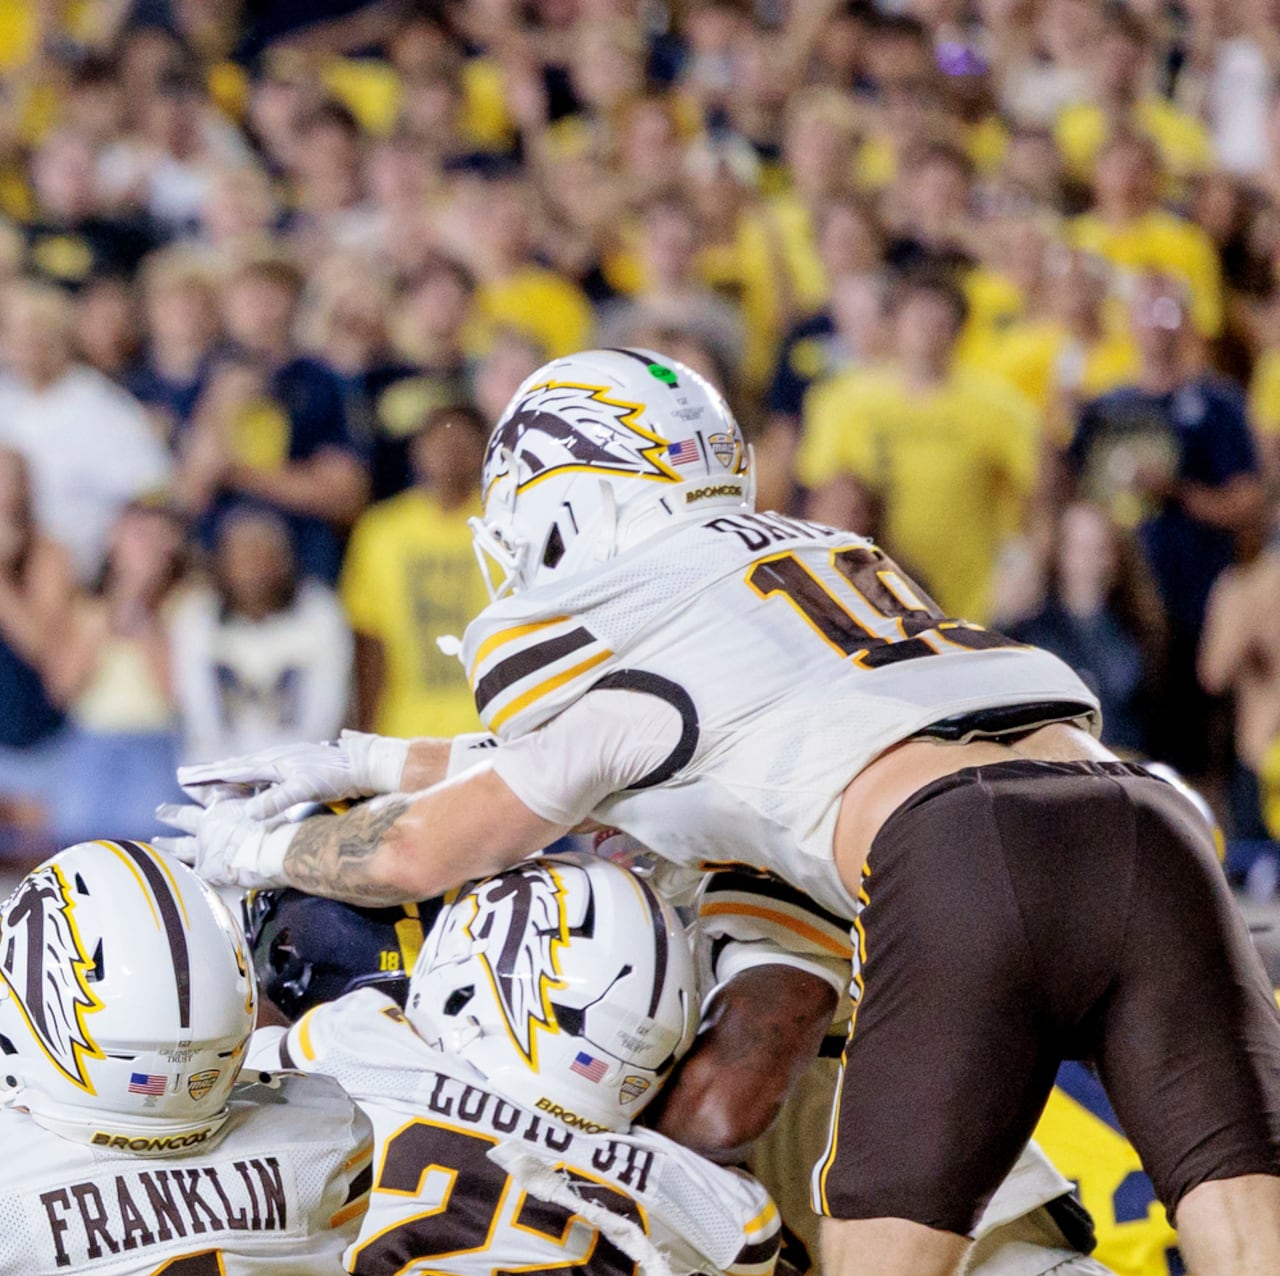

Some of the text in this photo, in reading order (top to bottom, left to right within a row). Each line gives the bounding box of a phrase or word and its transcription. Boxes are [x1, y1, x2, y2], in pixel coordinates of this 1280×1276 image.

[380, 950, 400, 971] 18
[89, 1127, 212, 1152] BRONCOS
[40, 1157, 287, 1268] FRANKLIN
